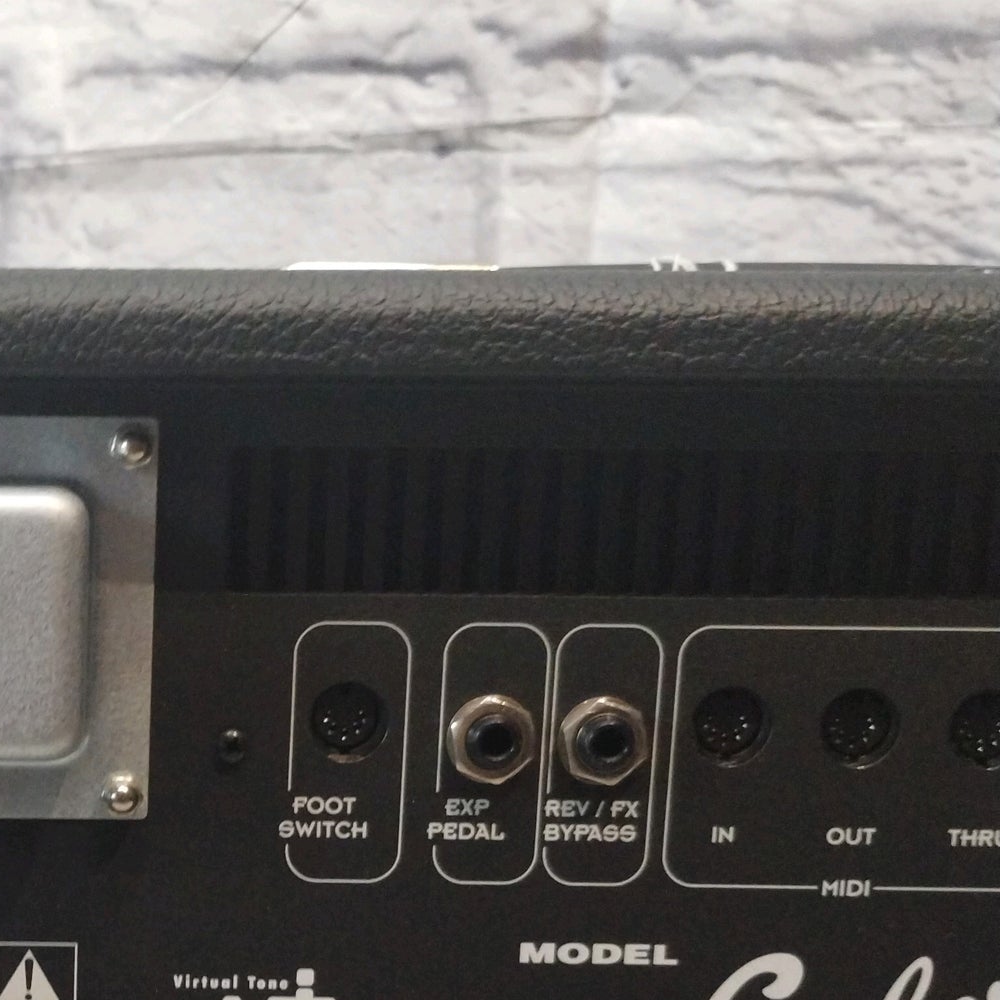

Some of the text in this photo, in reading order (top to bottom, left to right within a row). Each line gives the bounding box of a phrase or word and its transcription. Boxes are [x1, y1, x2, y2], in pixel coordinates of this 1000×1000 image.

[292, 796, 356, 816] FOOT
[444, 798, 489, 817] EXP
[544, 800, 588, 818] REV
[610, 801, 639, 818] FX
[278, 820, 368, 839] SWITCH
[426, 822, 505, 841] PEDAL
[543, 824, 637, 843] BYPASS
[711, 826, 737, 843] IN
[825, 827, 877, 845] OUT
[821, 879, 871, 897] MIDI
[519, 942, 679, 966] MODEL
[173, 974, 289, 991] Virtual Tone
